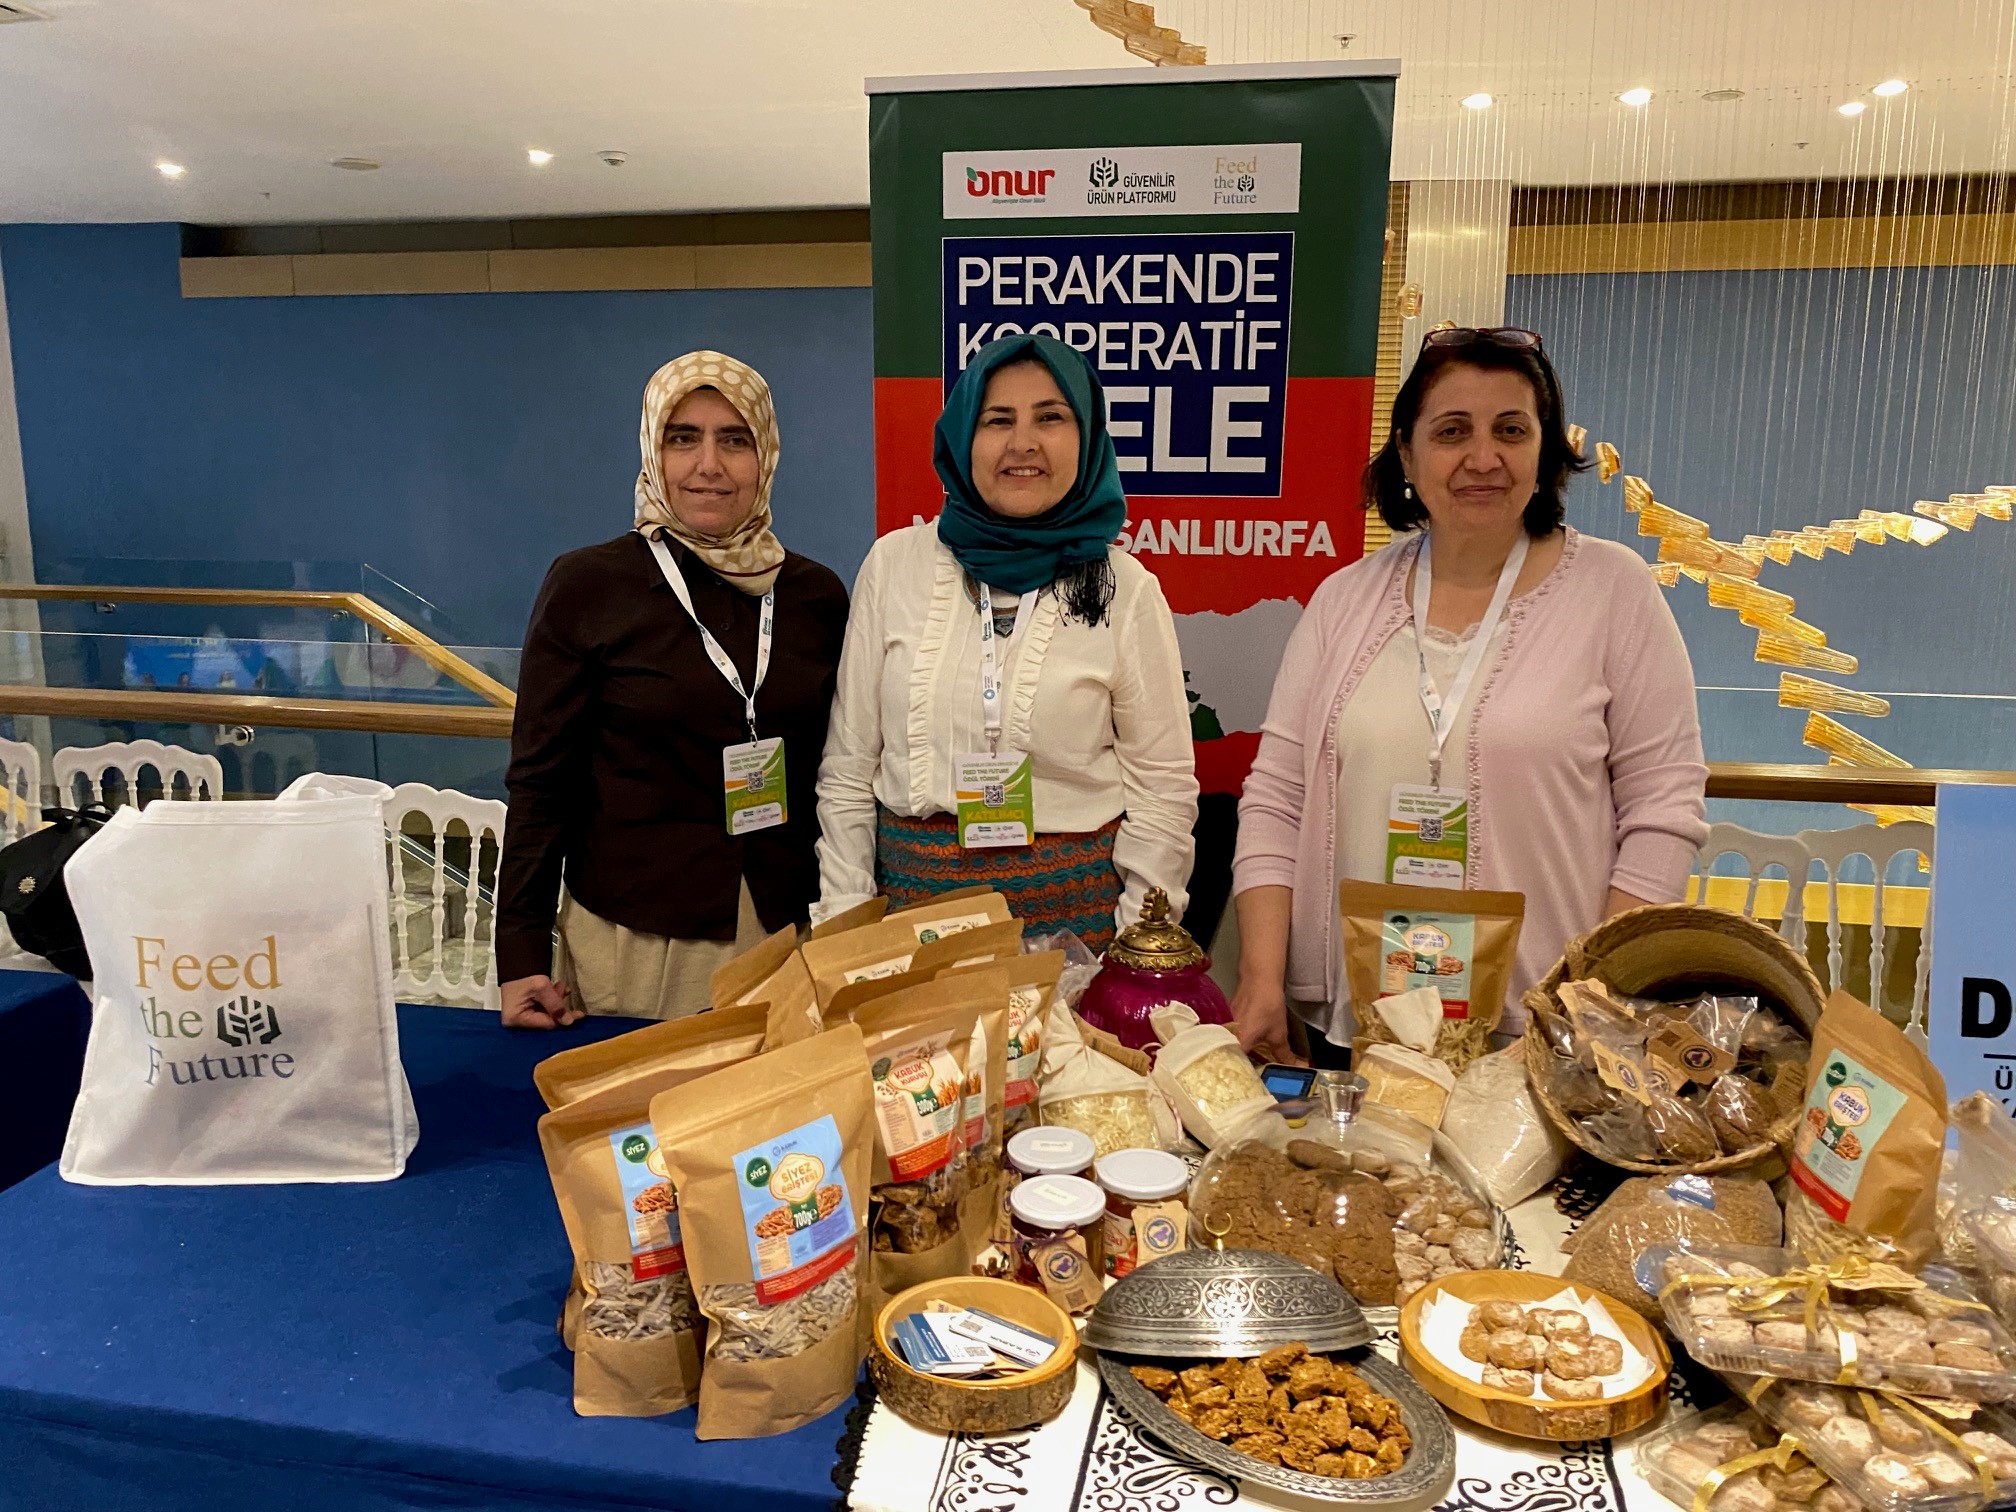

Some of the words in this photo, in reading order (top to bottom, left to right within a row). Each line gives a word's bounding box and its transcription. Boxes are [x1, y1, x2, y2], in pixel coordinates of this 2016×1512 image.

[1215, 155, 1257, 174] Feed
[967, 167, 1055, 197] onur
[1123, 173, 1175, 188] GÜVENİLİR
[1214, 176, 1234, 189] the
[1087, 189, 1115, 204] ÜRÜN
[1116, 190, 1176, 204] PLATFORMU
[1214, 191, 1257, 205] Future
[958, 252, 1280, 305] PERAKENDE
[131, 935, 283, 991] Feed
[140, 996, 204, 1038] the
[144, 1045, 295, 1086] Future
